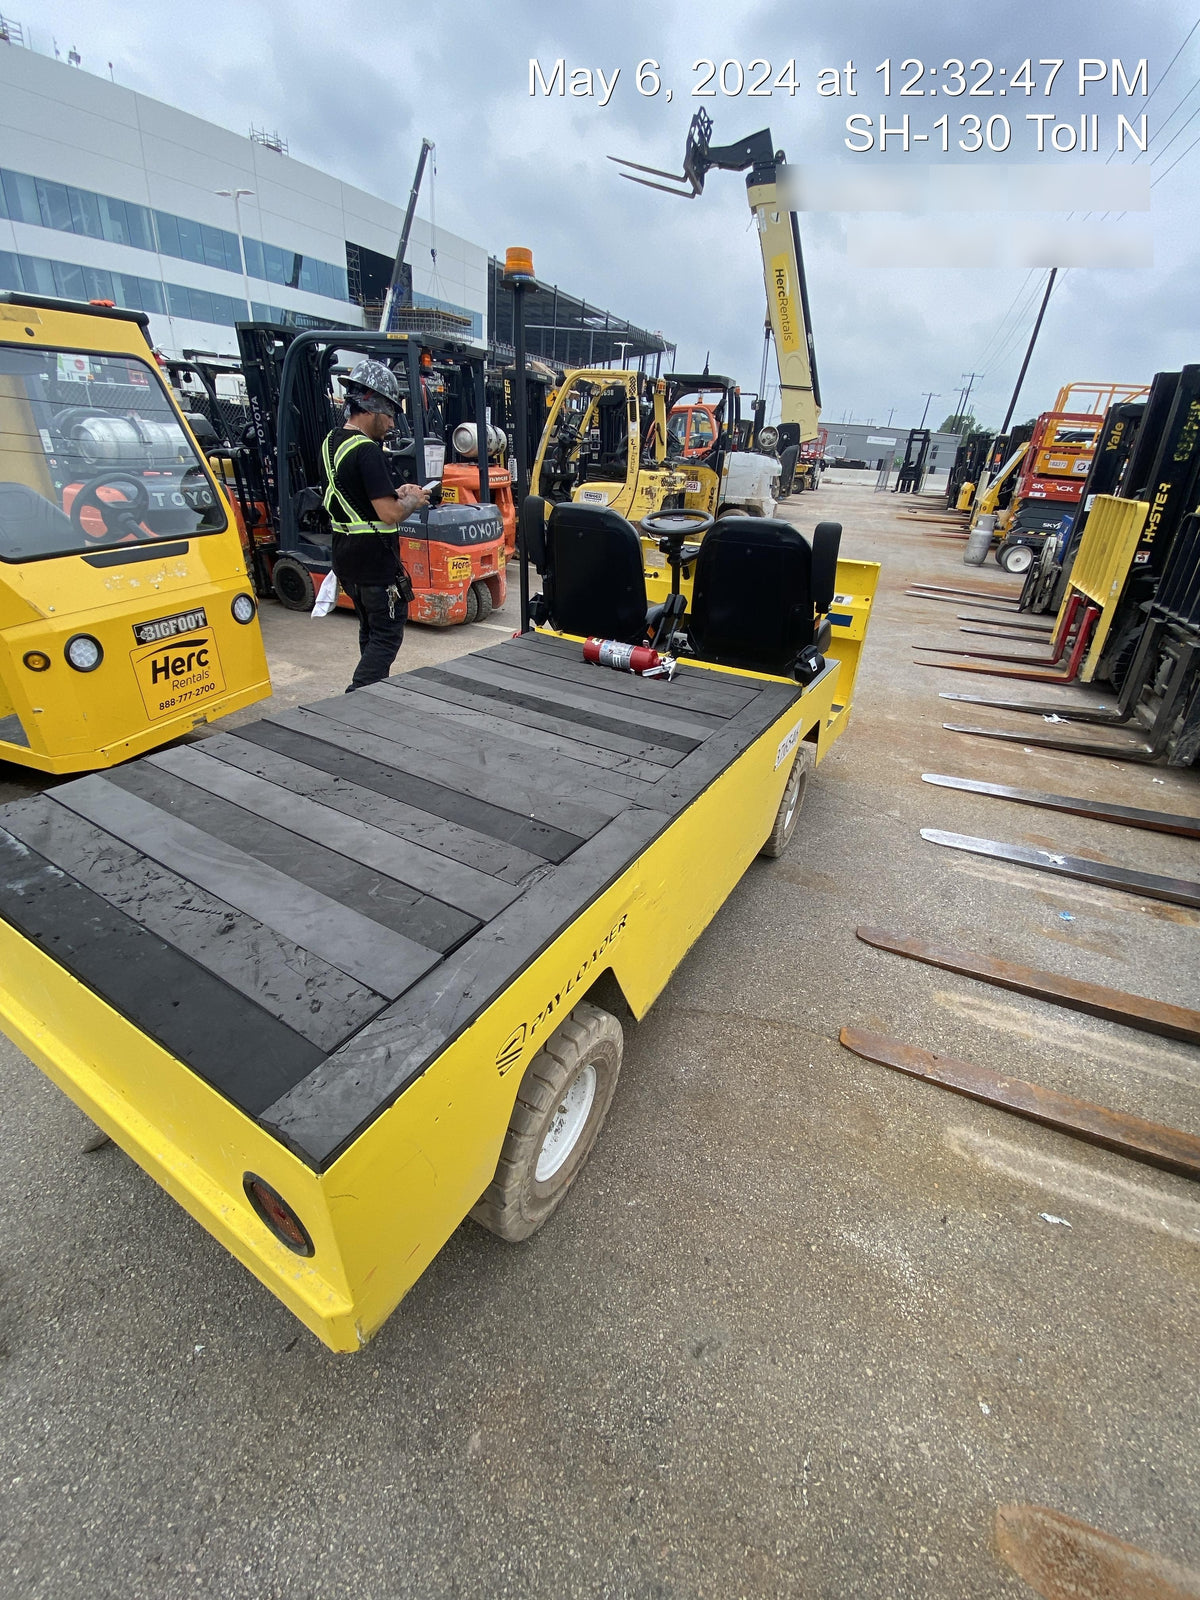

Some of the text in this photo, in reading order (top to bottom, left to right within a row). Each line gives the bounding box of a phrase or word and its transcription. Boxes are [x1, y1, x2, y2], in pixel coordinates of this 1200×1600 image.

[251, 395, 265, 446] TOYOTA
[1105, 421, 1125, 451] Yale
[152, 490, 212, 507] TOYO
[1142, 482, 1172, 543] HYSTER
[459, 520, 502, 541] TOYOTA
[142, 612, 206, 643] BIGFOOT
[151, 648, 210, 685] Herc
[172, 669, 210, 691] Rentals
[159, 682, 216, 711] 888-777-2700
[530, 913, 629, 1036] PAYLOADER
